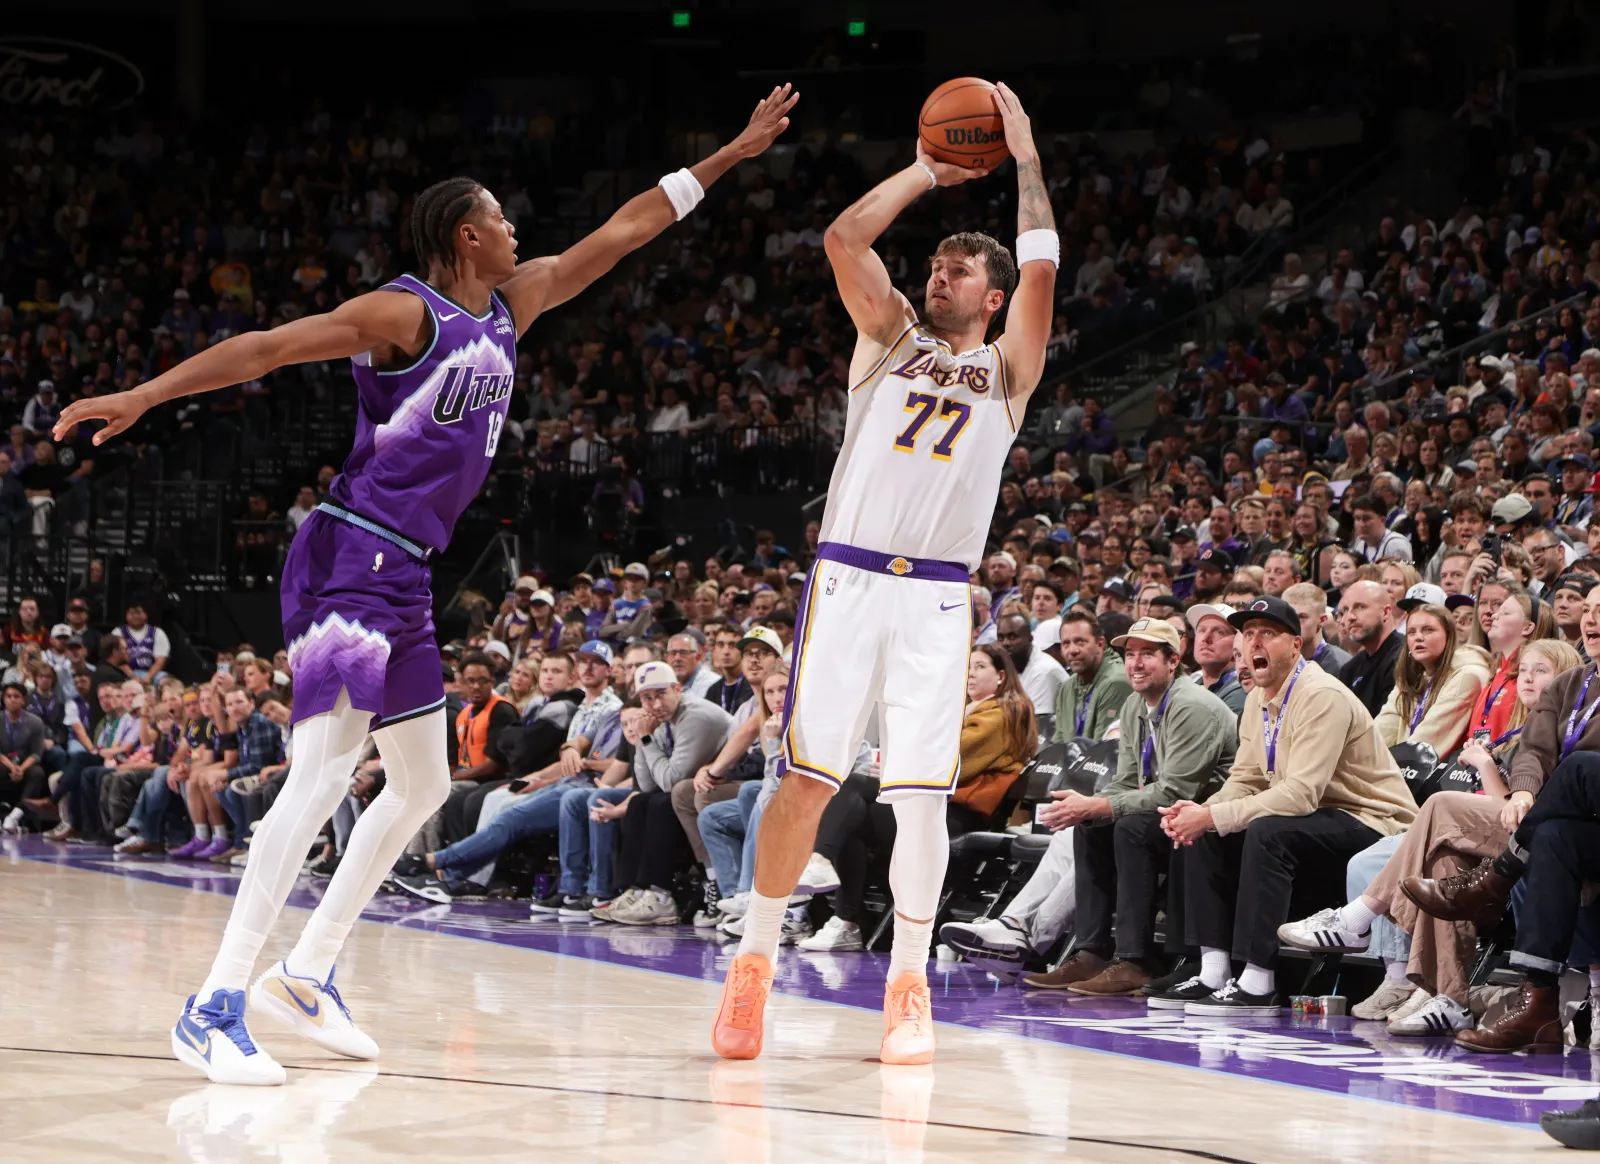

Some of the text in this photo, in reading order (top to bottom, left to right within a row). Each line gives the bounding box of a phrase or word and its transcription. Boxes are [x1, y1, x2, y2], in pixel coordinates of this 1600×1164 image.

[432, 364, 513, 425] UTAH
[485, 411, 503, 458] 19
[893, 390, 973, 462] 77
